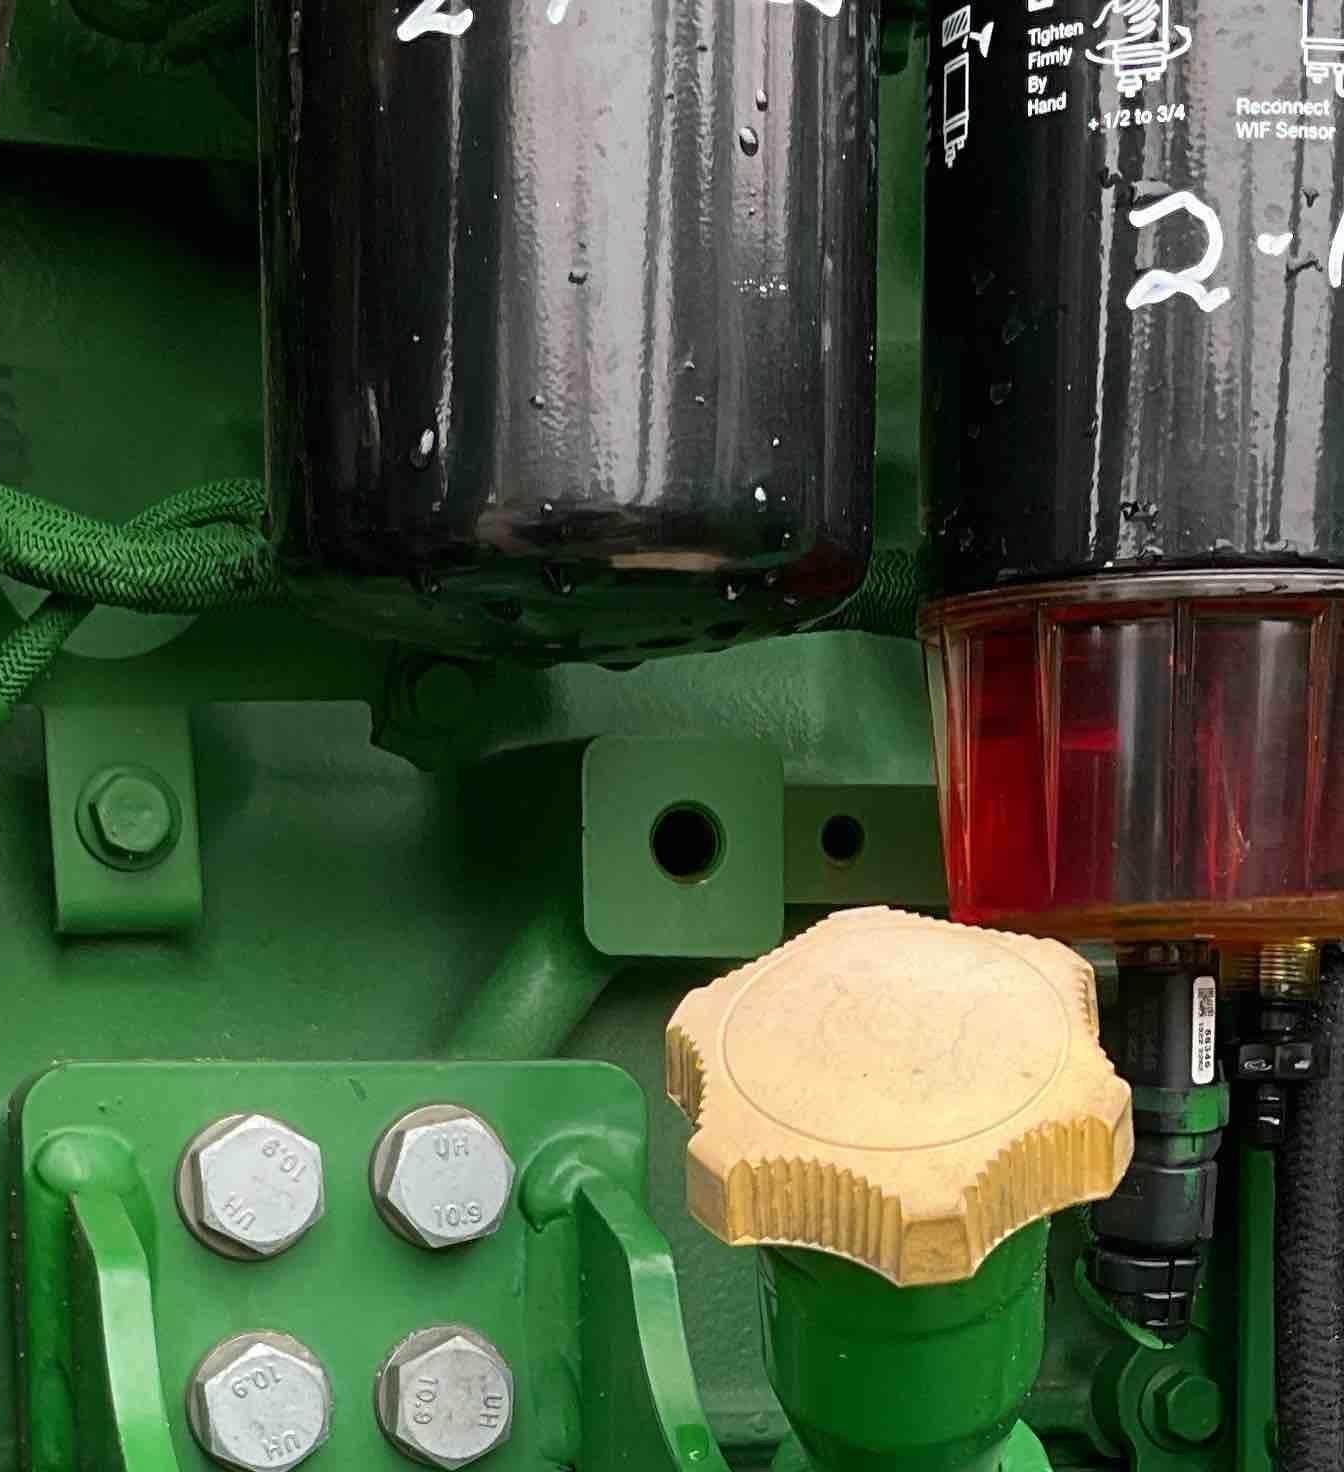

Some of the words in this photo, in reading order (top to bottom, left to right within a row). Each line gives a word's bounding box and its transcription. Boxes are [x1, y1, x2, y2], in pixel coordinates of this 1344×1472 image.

[1027, 22, 1084, 47] Tighten
[1027, 46, 1073, 70] Firmly
[1027, 75, 1048, 94] By
[1027, 90, 1067, 117] Hand
[1103, 109, 1131, 129] 1/2
[1134, 108, 1153, 125] to
[1156, 103, 1185, 123] 3/4
[1235, 97, 1331, 116] Reconnect
[1235, 121, 1271, 139] WIF
[1275, 121, 1336, 140] Sensor
[431, 1200, 483, 1229] 10.9
[231, 1362, 283, 1400] 10.9
[412, 1377, 440, 1426] 10.9
